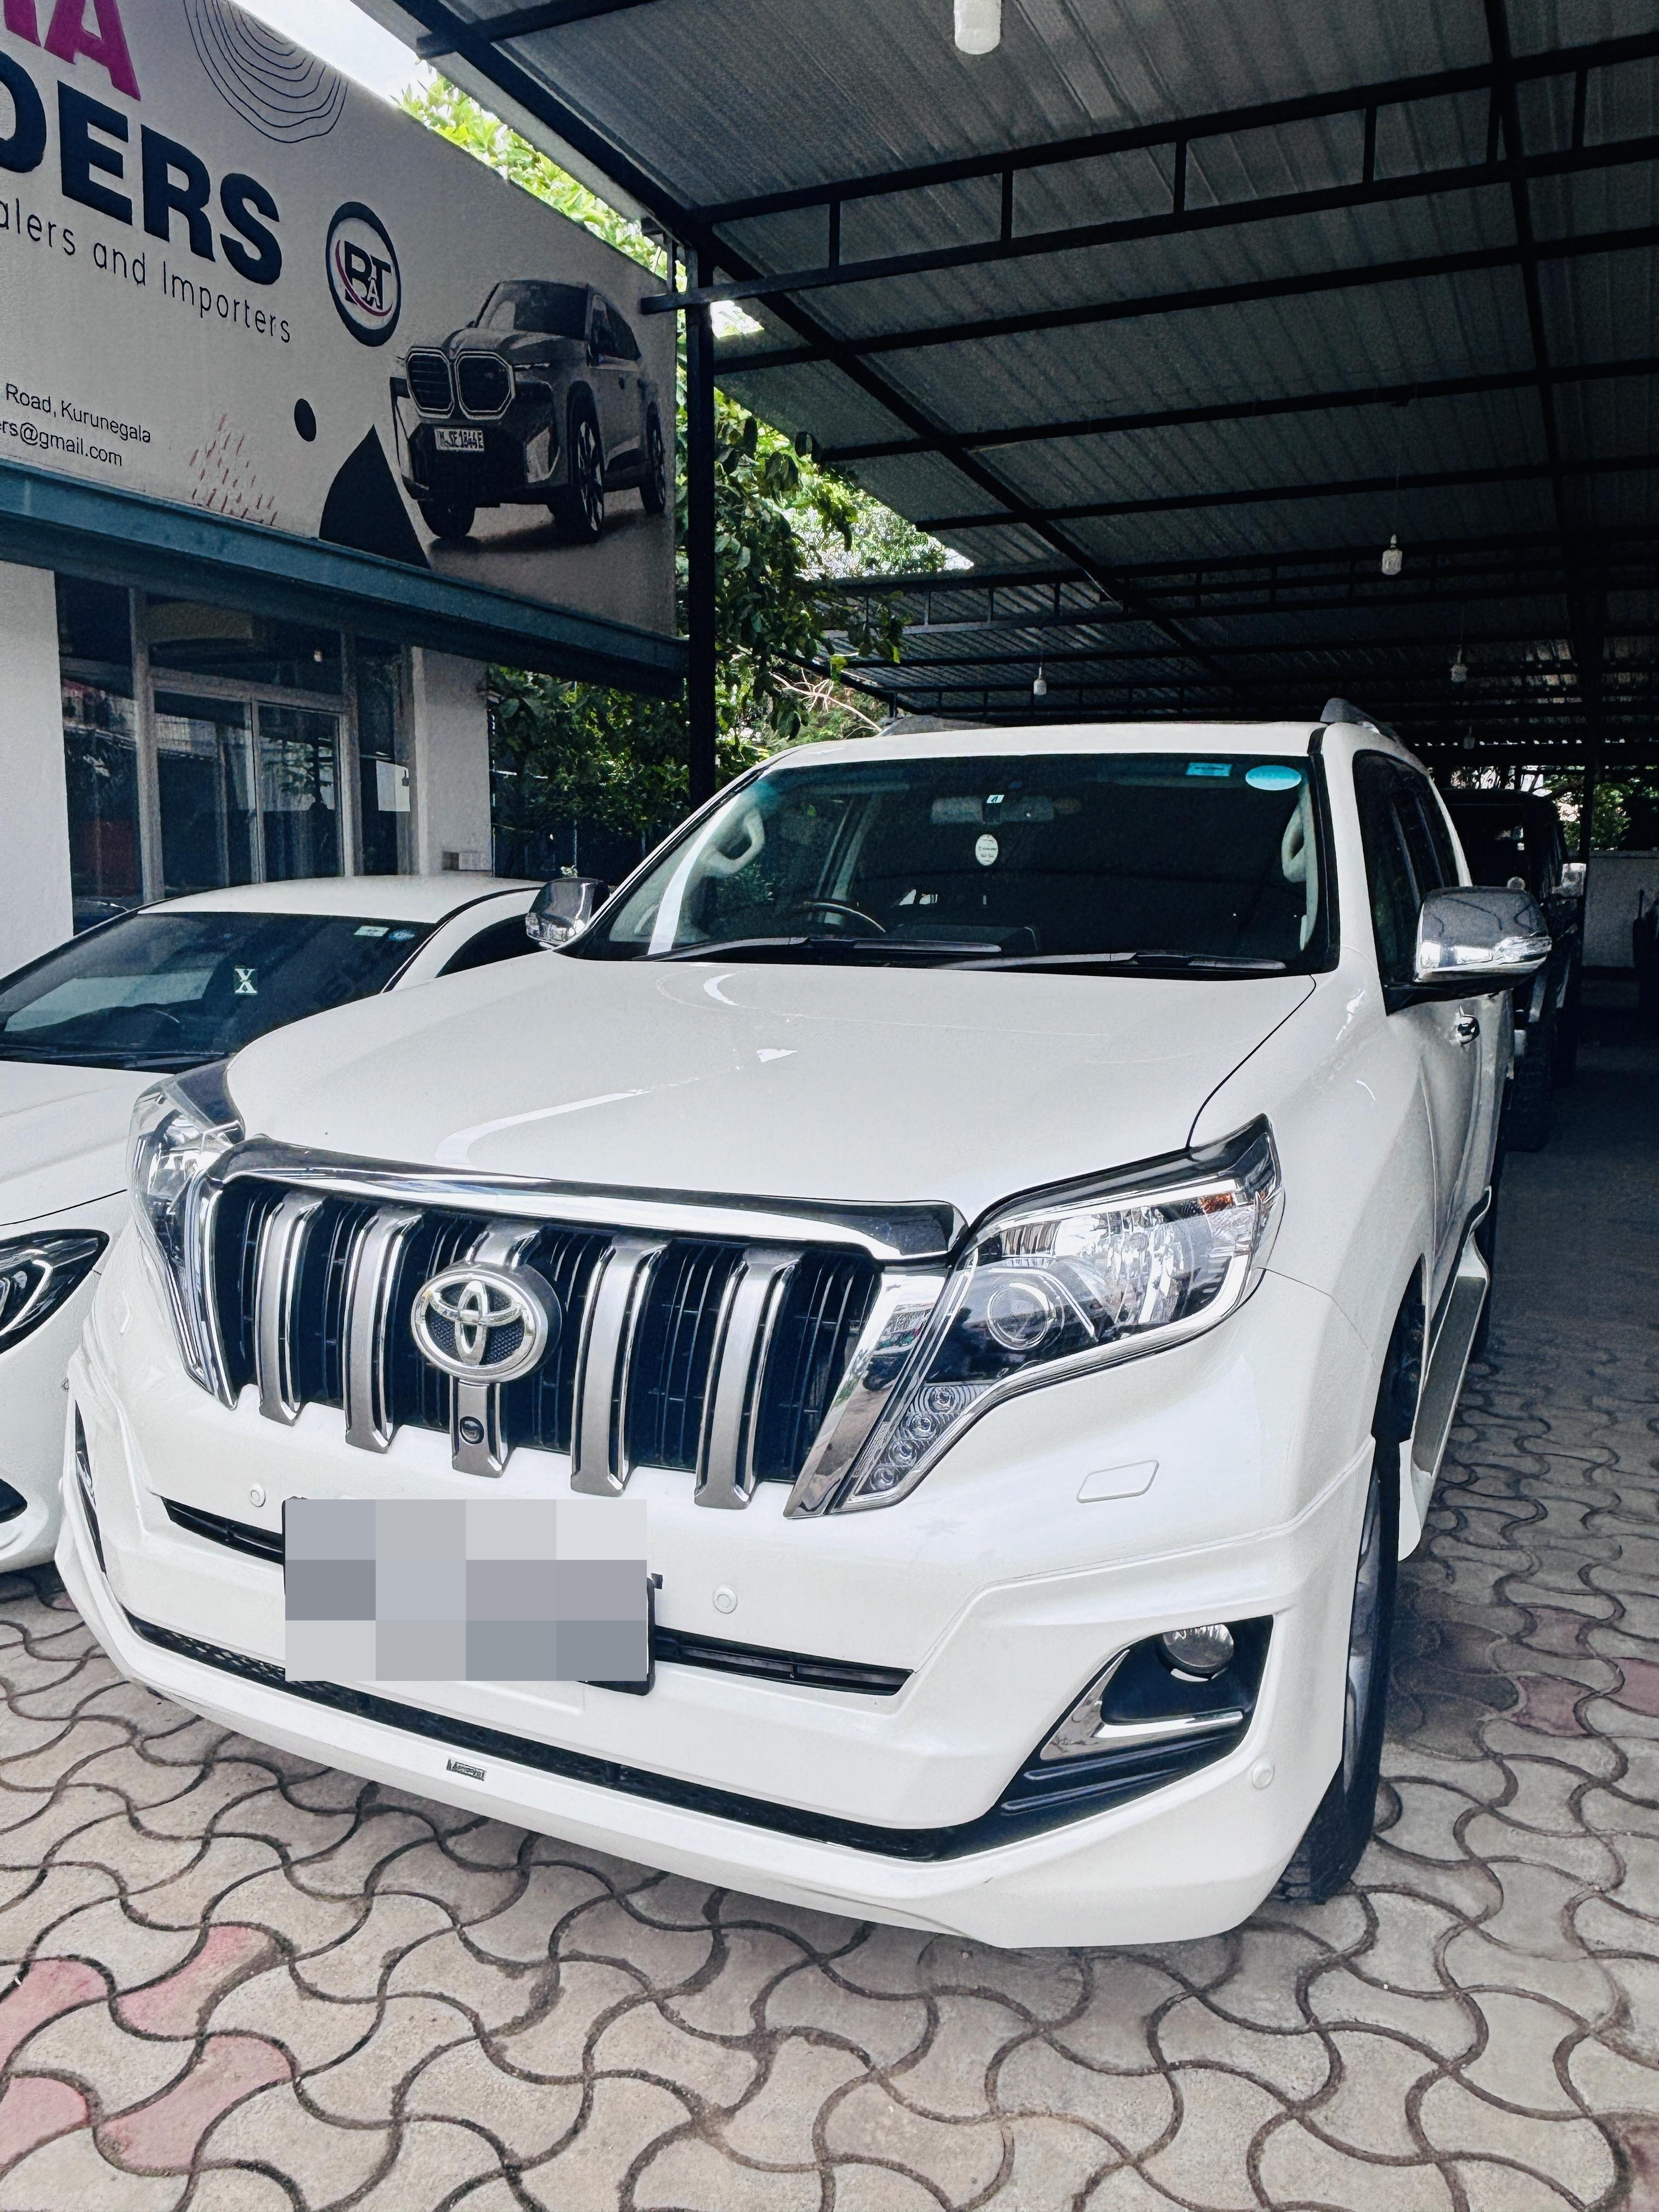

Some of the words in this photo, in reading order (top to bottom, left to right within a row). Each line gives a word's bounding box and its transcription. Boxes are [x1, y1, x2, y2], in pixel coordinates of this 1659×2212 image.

[93, 242, 145, 286] and
[163, 261, 290, 343] Importers
[6, 383, 56, 417] Road,
[61, 400, 150, 443] Kurunegala
[0, 421, 122, 466] rs@gmail.com
